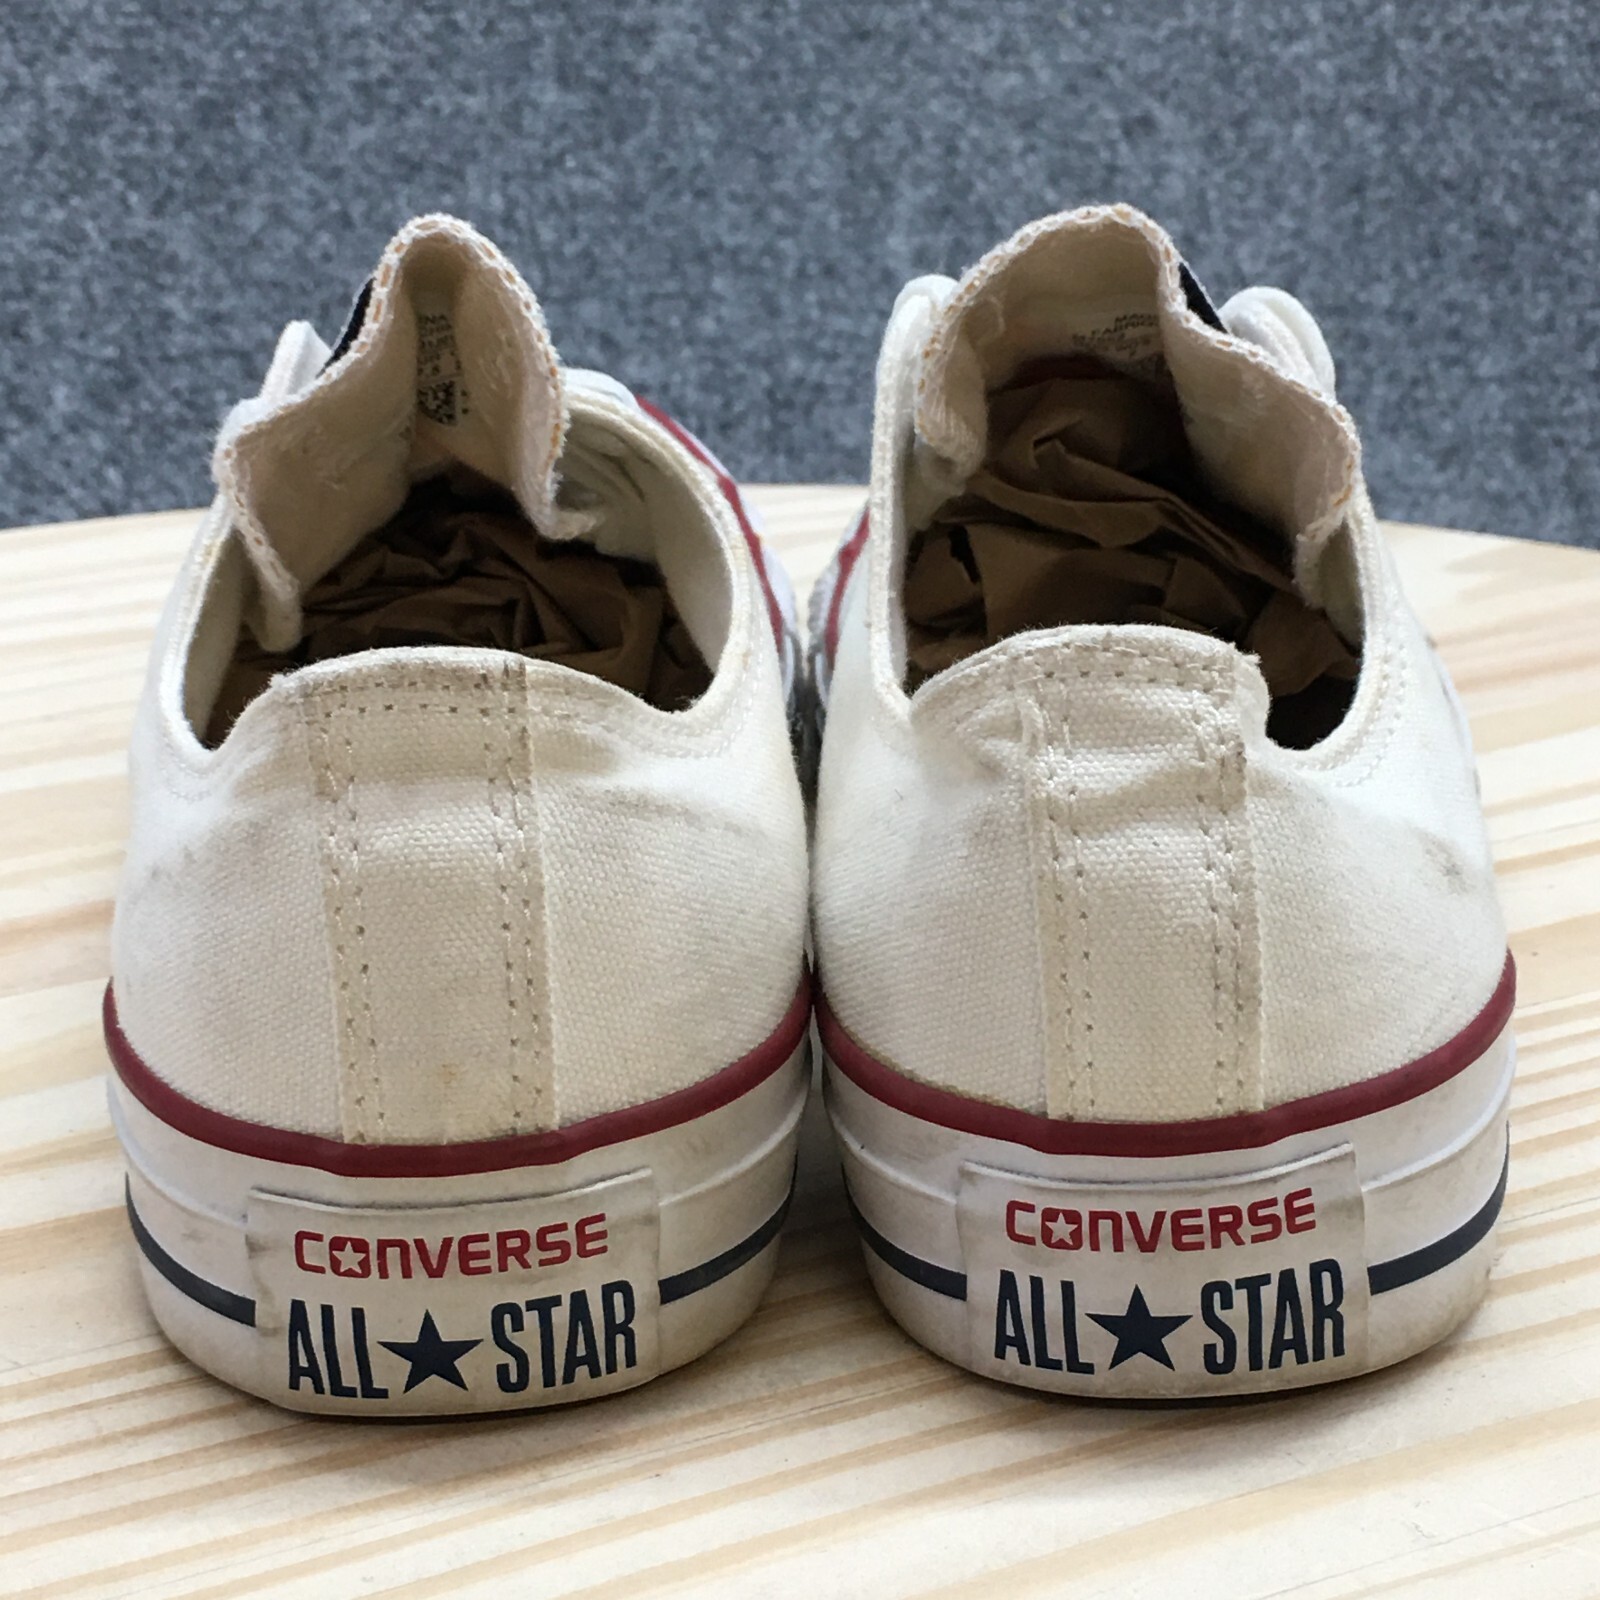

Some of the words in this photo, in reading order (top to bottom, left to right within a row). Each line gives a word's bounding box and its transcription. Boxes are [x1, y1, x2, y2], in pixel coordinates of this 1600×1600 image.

[294, 1213, 608, 1279] CONVERSE
[1005, 1187, 1316, 1253] CONVERSE
[288, 1298, 389, 1399] ALL
[490, 1279, 637, 1393] STAR
[994, 1269, 1095, 1375] ALL
[1200, 1258, 1345, 1375] STAR
